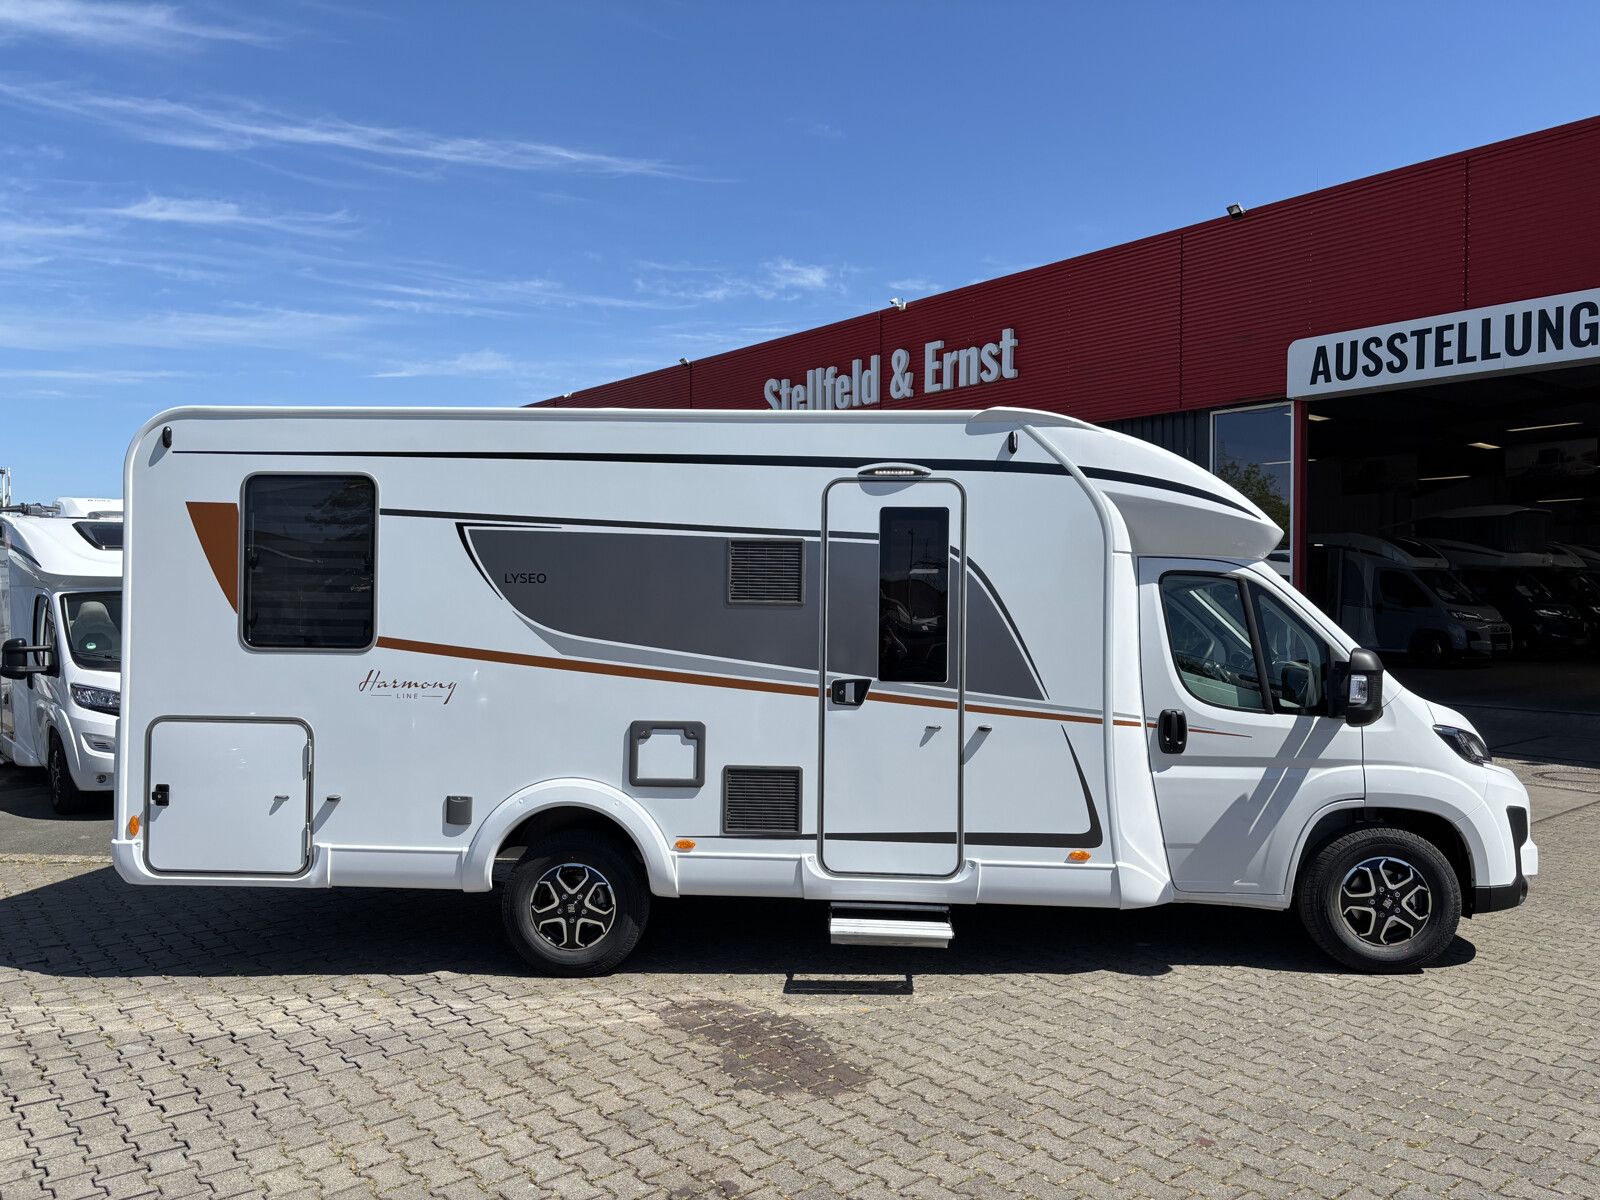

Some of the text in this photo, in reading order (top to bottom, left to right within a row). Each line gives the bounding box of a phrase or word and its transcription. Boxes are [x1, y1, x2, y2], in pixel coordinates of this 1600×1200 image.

[1309, 301, 1600, 386] AUSSTELLUNG
[764, 327, 1019, 411] Stellfeld & Ernst
[504, 572, 547, 585] LYSEO
[358, 669, 458, 705] Harmony
[396, 692, 419, 700] LINE
